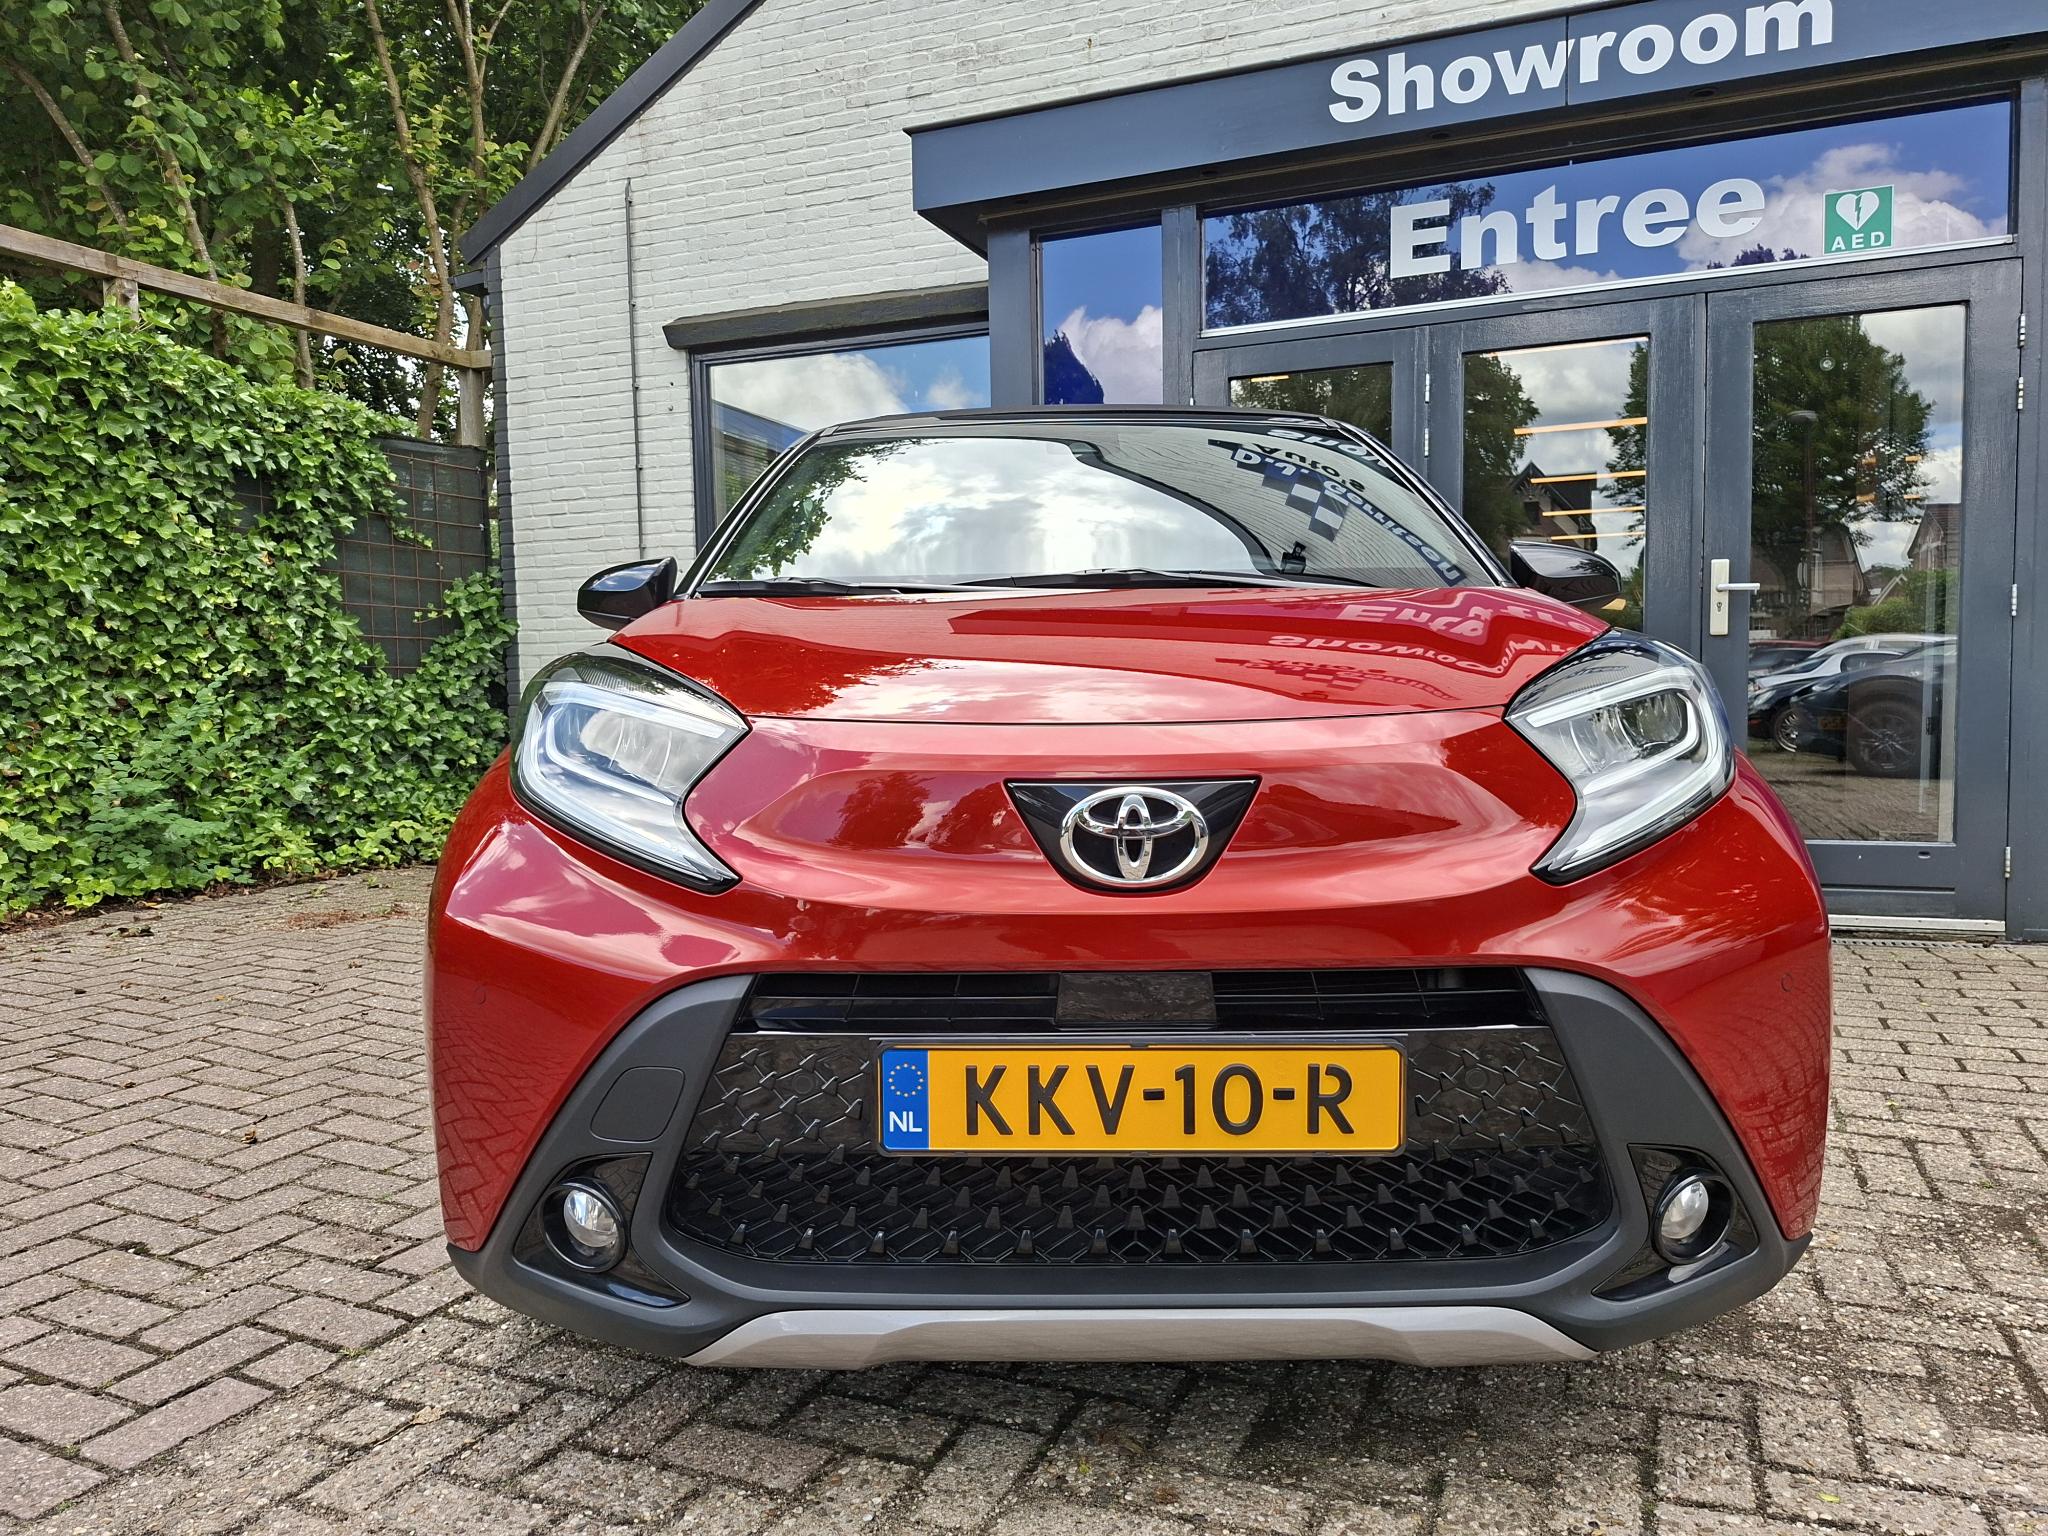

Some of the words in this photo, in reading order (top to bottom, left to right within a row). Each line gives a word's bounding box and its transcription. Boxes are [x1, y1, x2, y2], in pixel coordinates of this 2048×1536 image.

[1328, 0, 1833, 124] Showroom
[1389, 178, 1765, 279] Entree
[1831, 231, 1885, 252] AED
[889, 1111, 923, 1132] NL
[964, 1063, 1355, 1136] KKV-10-R
